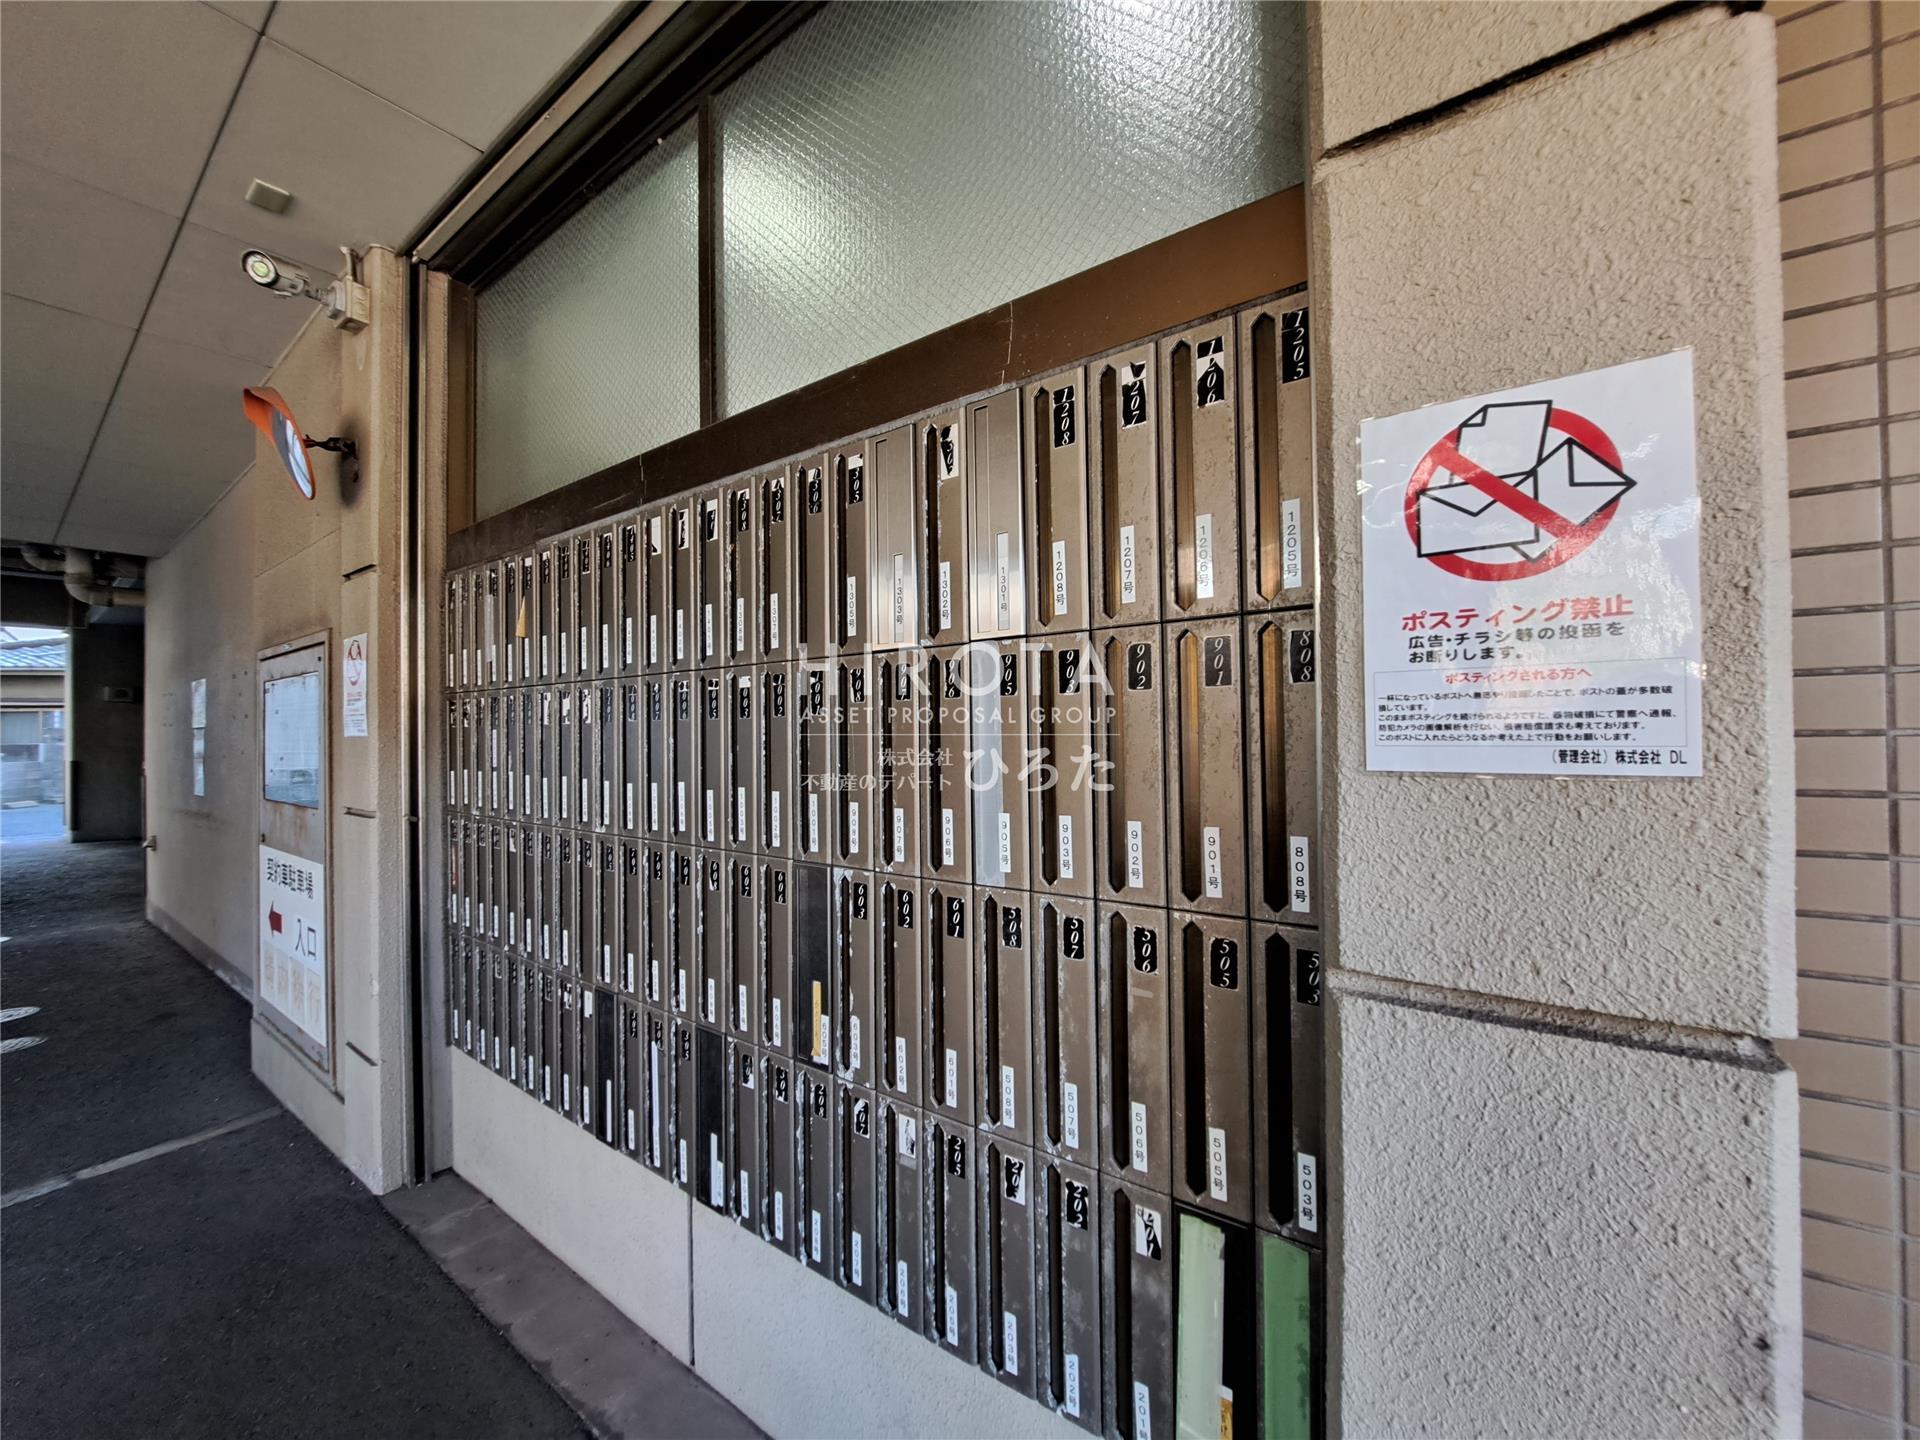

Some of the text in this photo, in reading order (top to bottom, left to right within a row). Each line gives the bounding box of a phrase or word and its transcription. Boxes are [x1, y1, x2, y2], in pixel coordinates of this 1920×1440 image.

[1293, 310, 1306, 379] 1205
[1060, 388, 1072, 447] 1208
[1123, 535, 1133, 595] 1207号
[1198, 524, 1210, 588] 1206号
[1286, 512, 1300, 577] 1205号
[1055, 550, 1066, 607] 1208号
[1402, 593, 1634, 632] ポスティング禁止
[1065, 650, 1076, 693] 903
[1135, 644, 1146, 689] 902
[1213, 638, 1224, 686] 901
[1299, 630, 1312, 682] 808
[1409, 645, 1523, 663] お断りします。
[1445, 667, 1592, 684] ポスティングされる方へ
[1615, 749, 1662, 765] 株式会社
[1670, 749, 1688, 764] DL
[1061, 823, 1071, 870] 903号
[1131, 830, 1141, 880] 902号
[1208, 836, 1220, 889] 901号
[1294, 846, 1307, 904] 808号
[295, 917, 317, 960] 入口
[1070, 918, 1080, 959] 507
[1140, 929, 1152, 973] 506
[1219, 939, 1231, 988] 505
[1308, 953, 1320, 1004] 503
[1067, 1091, 1077, 1140] 507号
[1135, 1112, 1145, 1164] 506号
[1212, 1137, 1224, 1192] 505号
[1302, 1164, 1315, 1221] 503号
